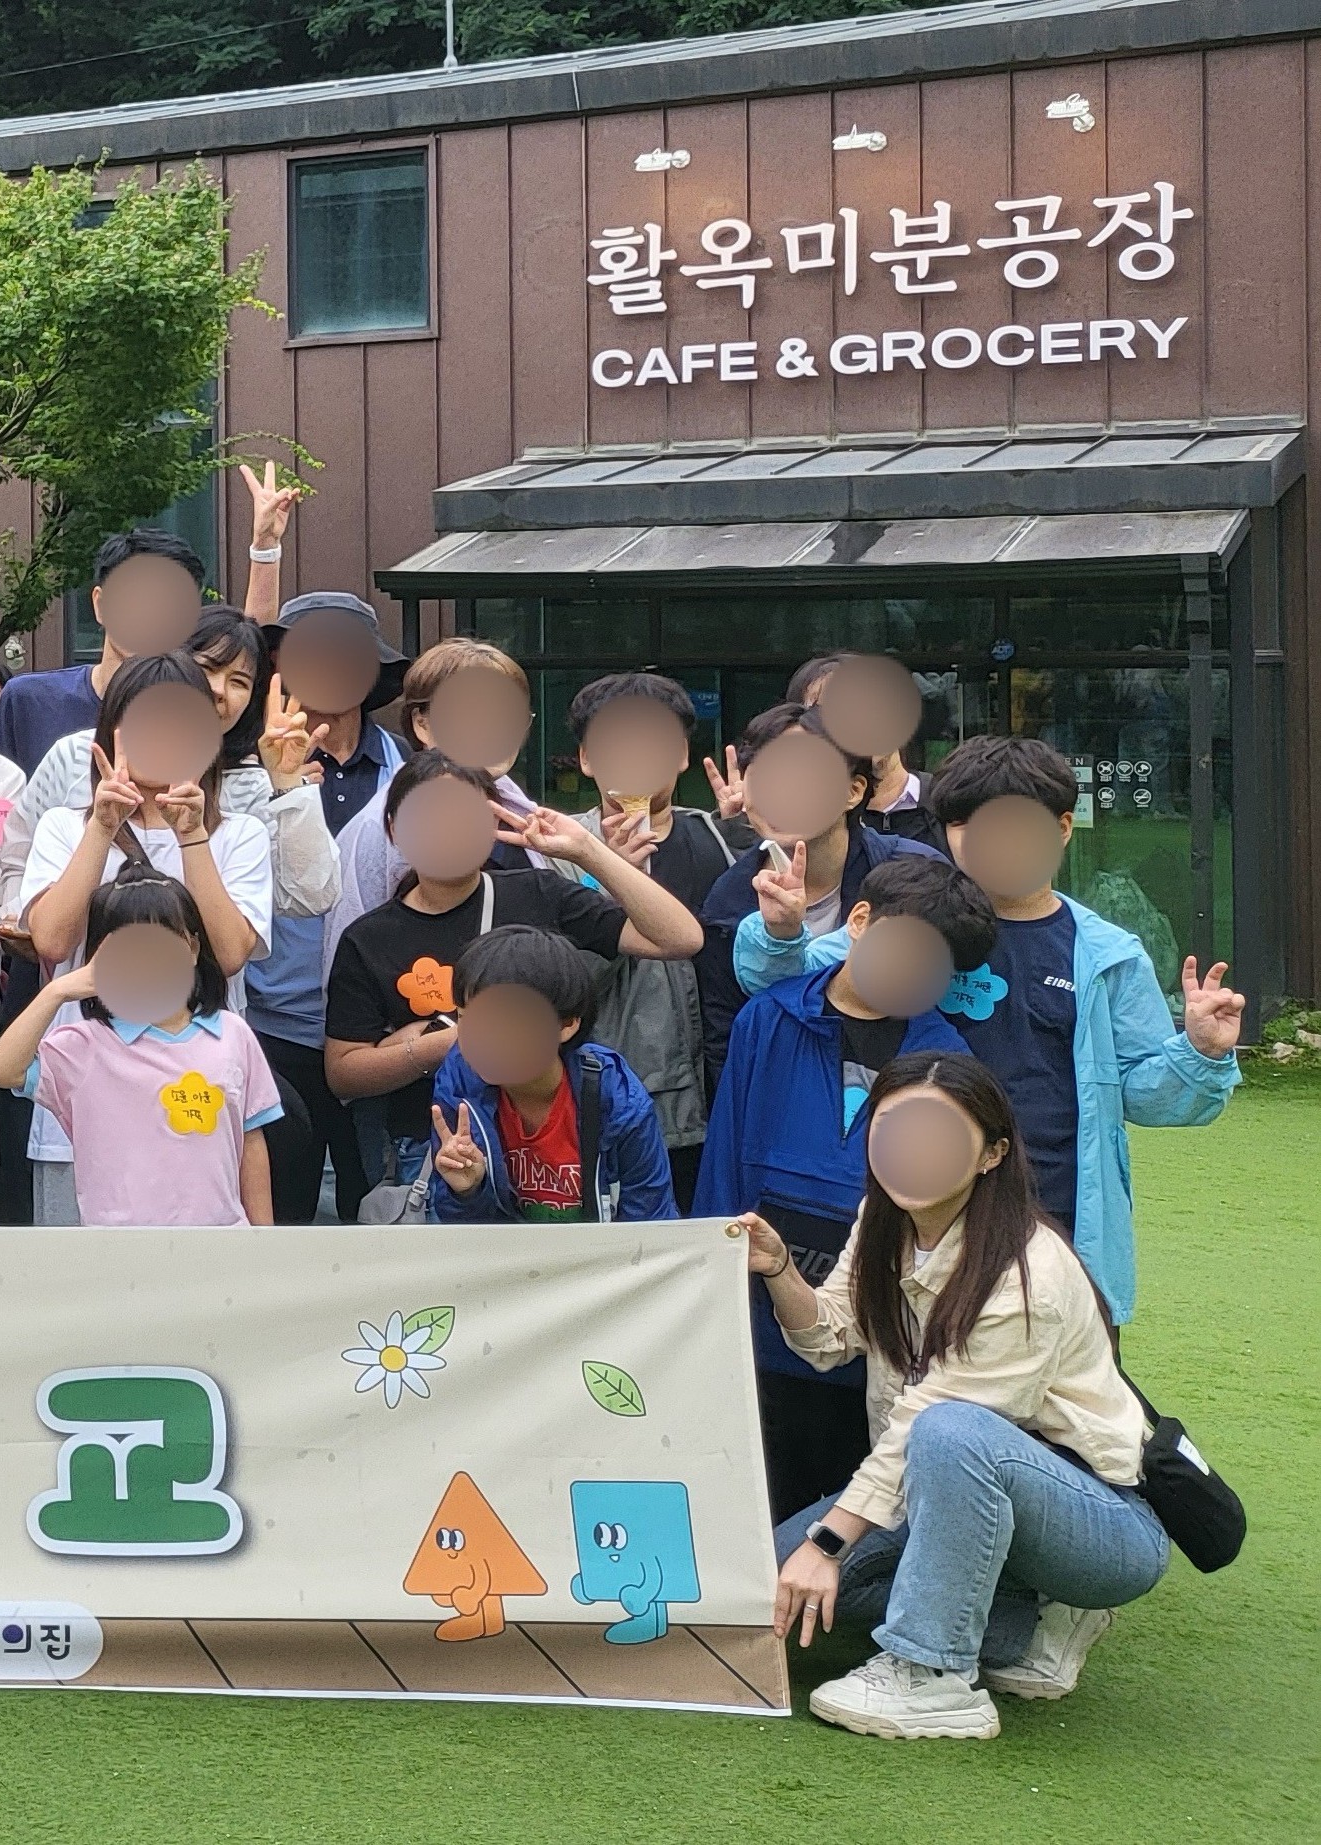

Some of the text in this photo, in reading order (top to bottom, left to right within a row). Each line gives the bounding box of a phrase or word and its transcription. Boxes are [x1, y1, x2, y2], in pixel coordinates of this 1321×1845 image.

[587, 182, 1194, 315] 활옥미분공장
[592, 316, 1189, 388] CAFE & GROCERY
